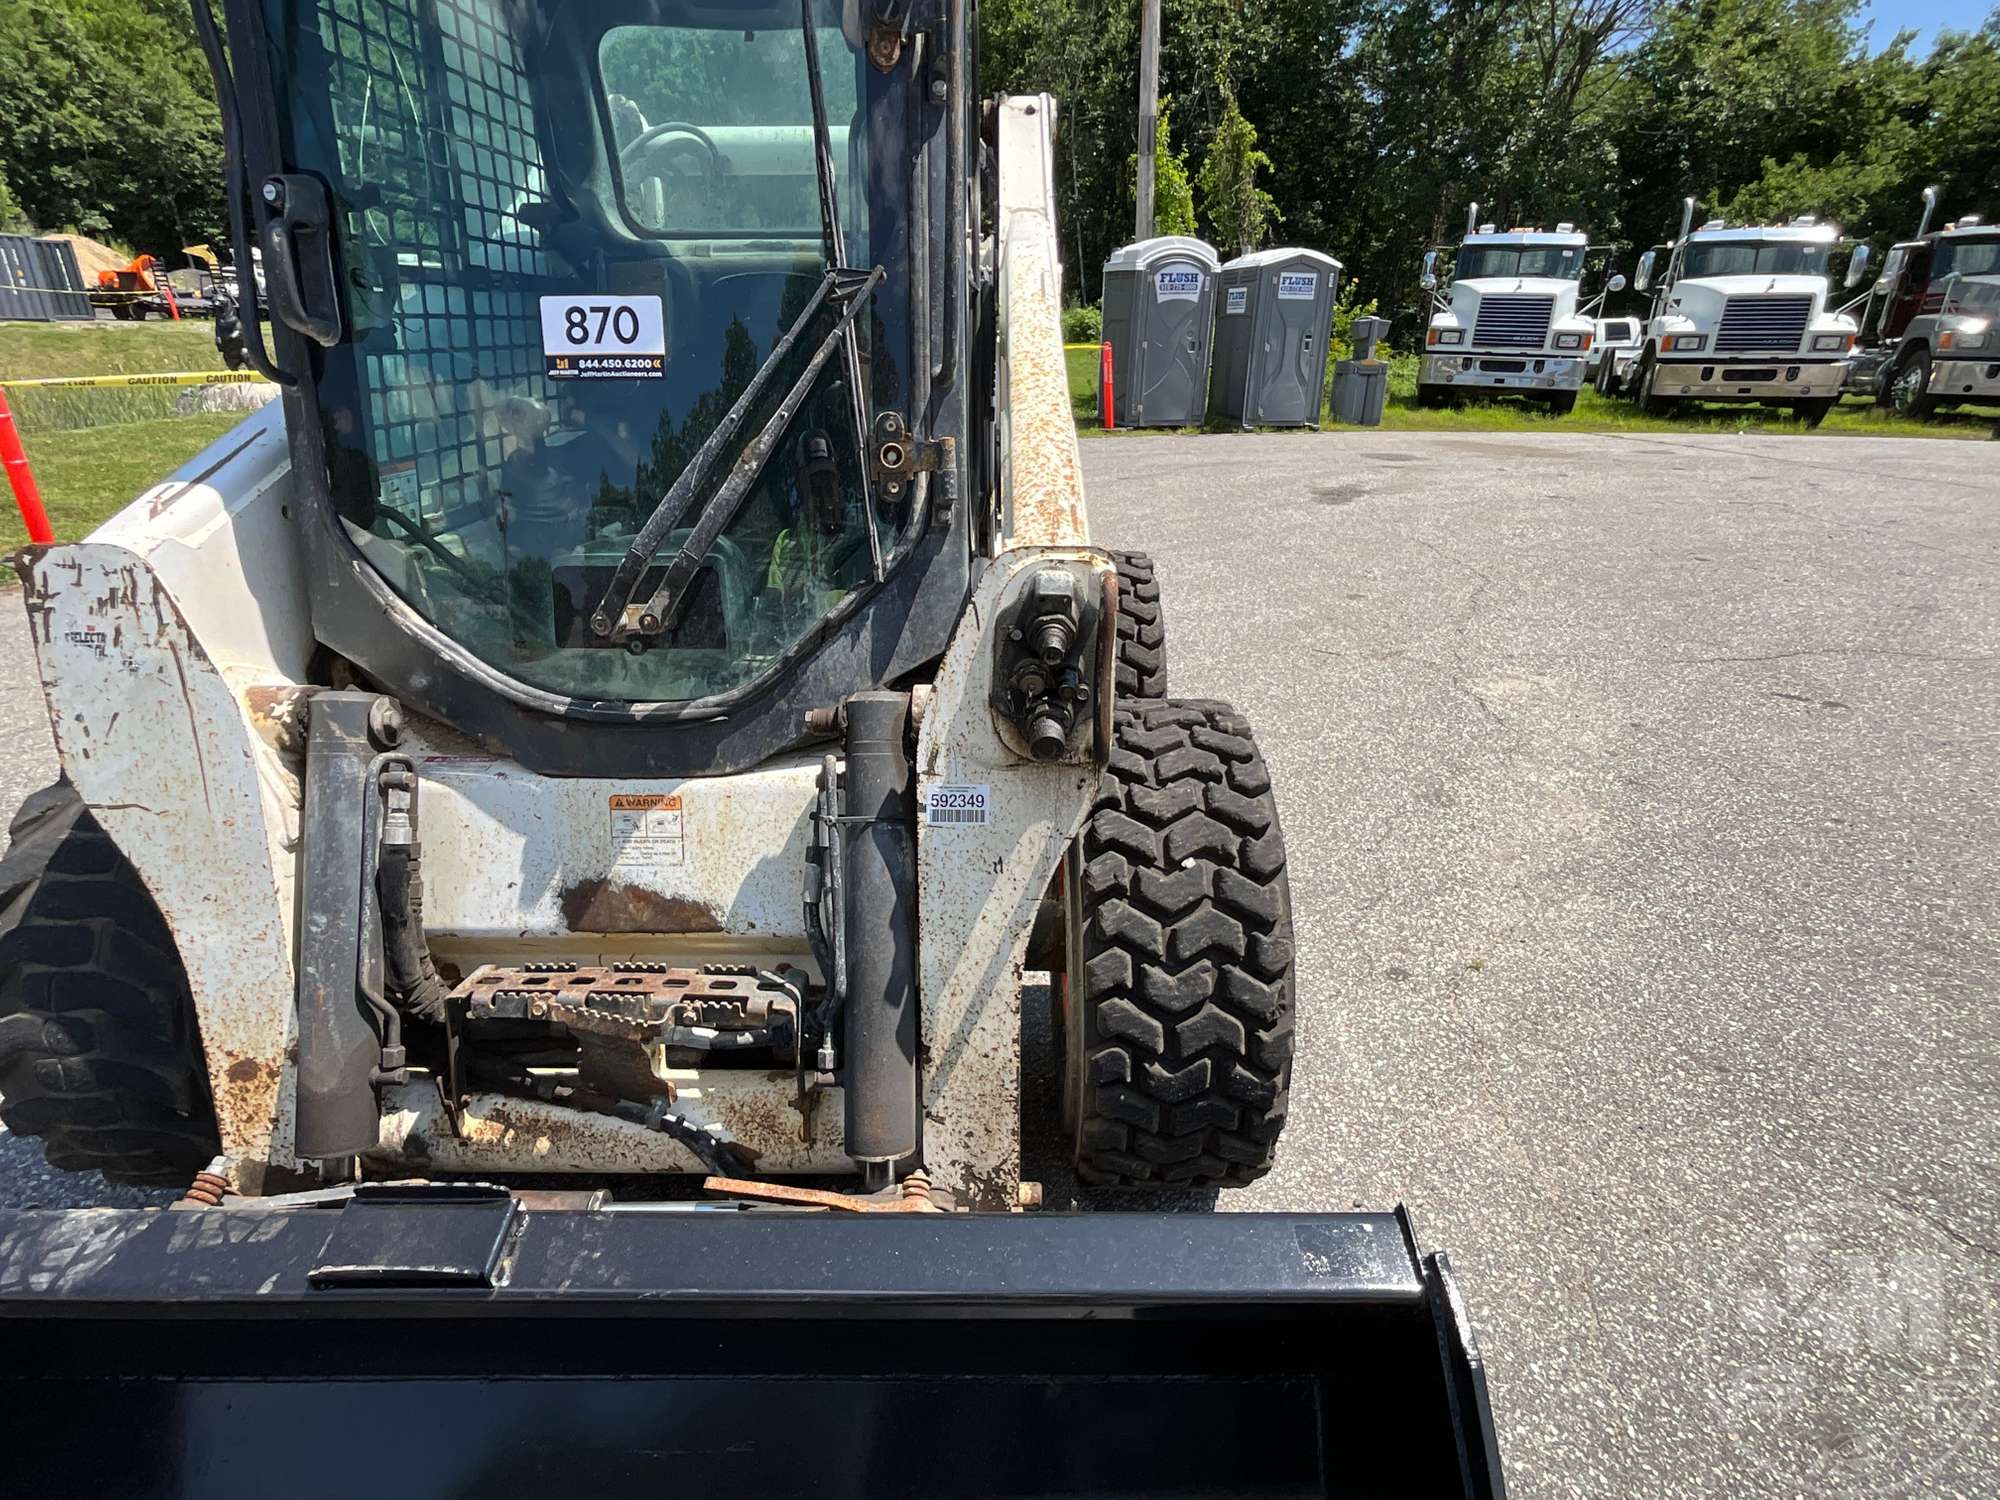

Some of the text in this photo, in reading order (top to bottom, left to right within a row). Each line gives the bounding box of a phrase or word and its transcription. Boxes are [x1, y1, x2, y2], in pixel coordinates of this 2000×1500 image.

[1159, 272, 1200, 283] FLUSH
[1281, 276, 1315, 286] FLUSH
[565, 305, 639, 345] 870
[578, 359, 652, 369] 844.450.6200
[127, 376, 178, 385] CAUTION
[206, 373, 251, 383] CAUTION
[626, 798, 676, 808] WARNING
[930, 793, 985, 808] 592349
